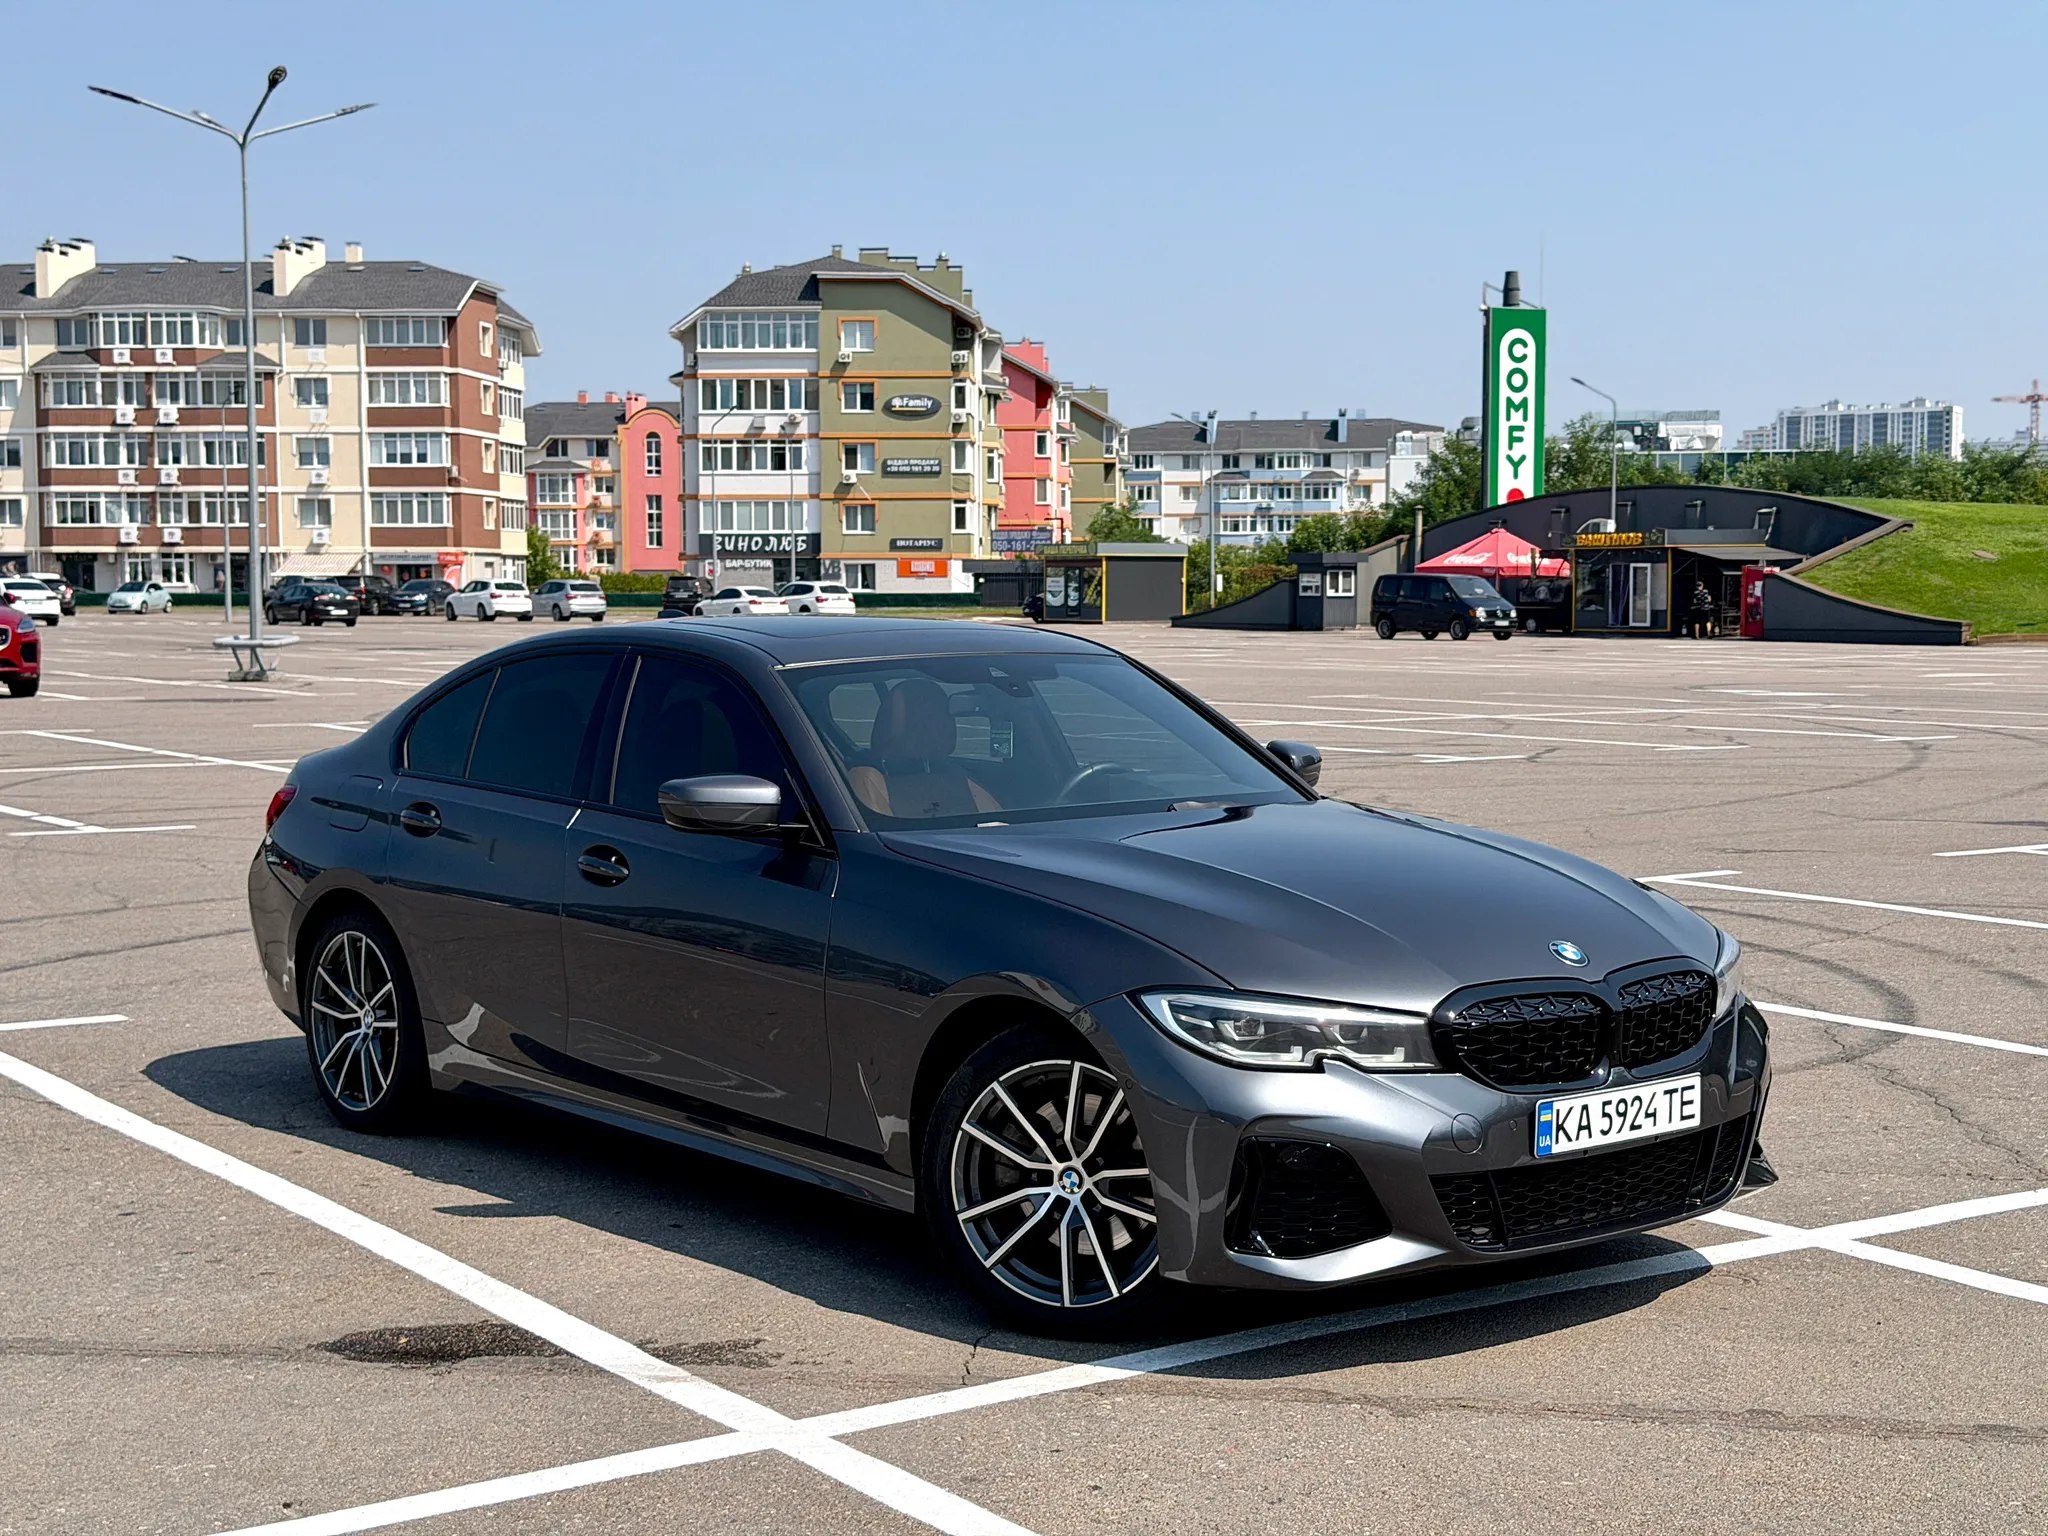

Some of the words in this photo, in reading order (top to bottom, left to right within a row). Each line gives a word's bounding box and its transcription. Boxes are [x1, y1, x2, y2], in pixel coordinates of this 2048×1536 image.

[903, 397, 933, 408] Family
[1505, 337, 1529, 480] COMFY
[1555, 1104, 1592, 1144] KA
[1600, 1091, 1657, 1136] 5924
[1663, 1084, 1696, 1125] TE
[1539, 1135, 1551, 1147] UA
